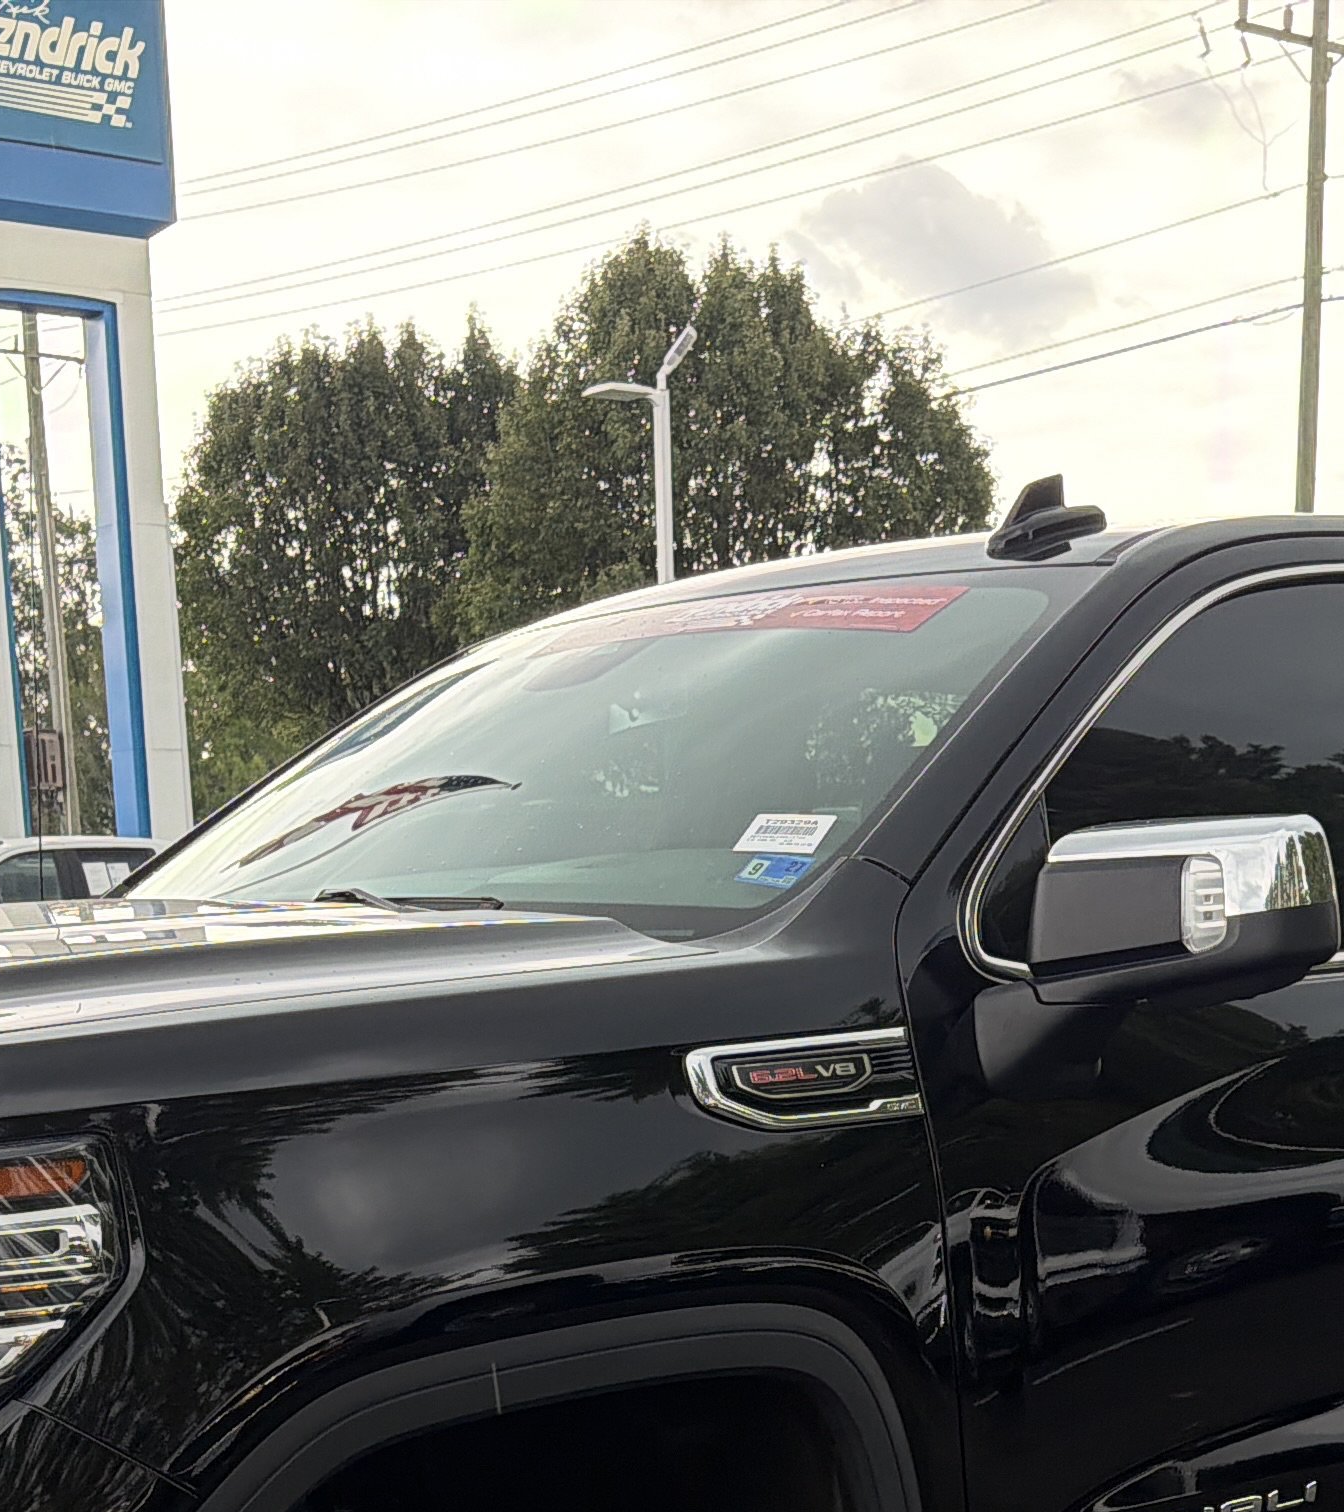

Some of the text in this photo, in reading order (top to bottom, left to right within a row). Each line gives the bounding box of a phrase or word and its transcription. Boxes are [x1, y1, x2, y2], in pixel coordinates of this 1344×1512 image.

[61, 71, 102, 90] BUICK
[104, 78, 135, 95] GMC
[748, 862, 765, 876] 9
